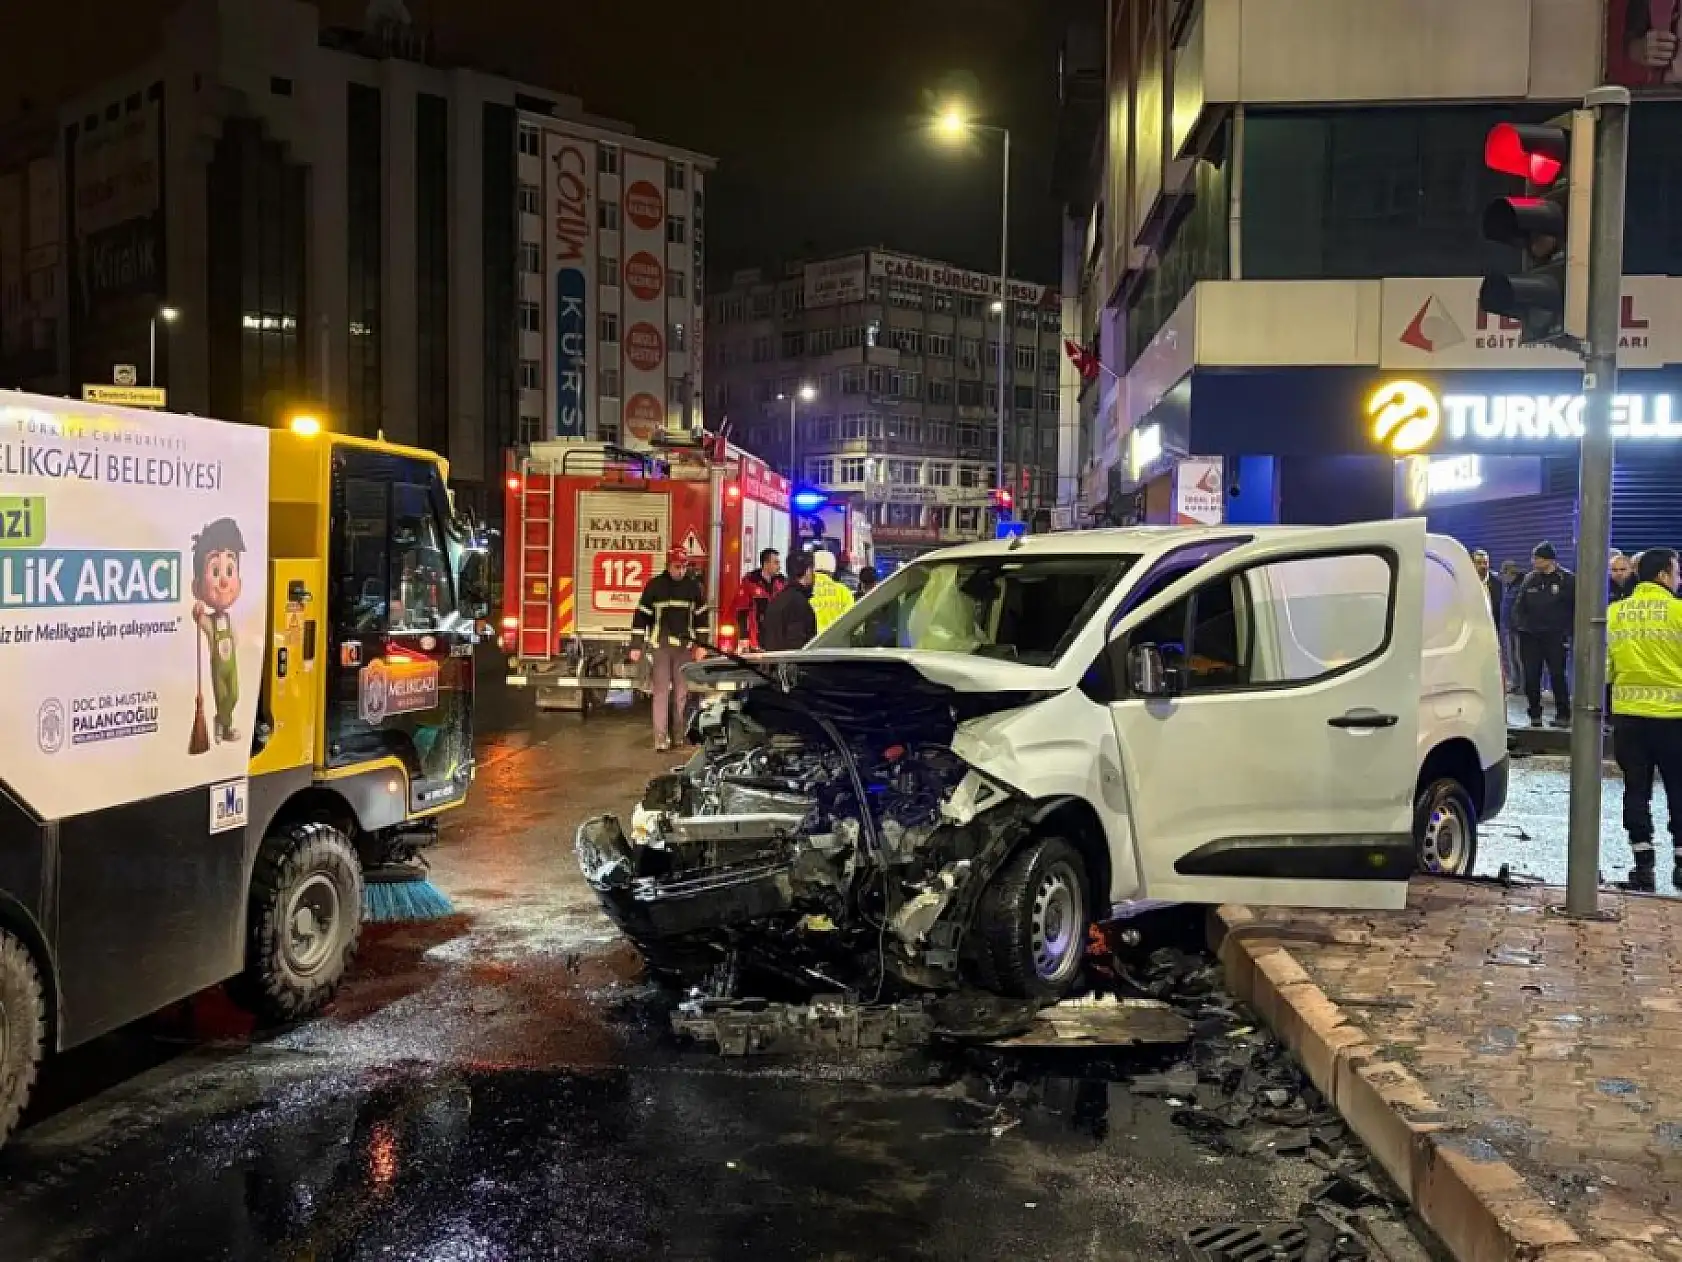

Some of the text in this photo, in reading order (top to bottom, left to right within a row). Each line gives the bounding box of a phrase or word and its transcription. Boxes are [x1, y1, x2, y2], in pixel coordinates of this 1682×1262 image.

[560, 297, 581, 427] KURS
[107, 455, 222, 490] BELEDİYESİ
[590, 518, 659, 532] KAYSERİ
[75, 557, 178, 602] ARACI
[601, 559, 643, 588] 112
[15, 624, 33, 643] bir
[35, 621, 94, 643] Melikgazi
[116, 691, 158, 707] MUSTAFA
[73, 706, 158, 733] PALANCIOĞLU
